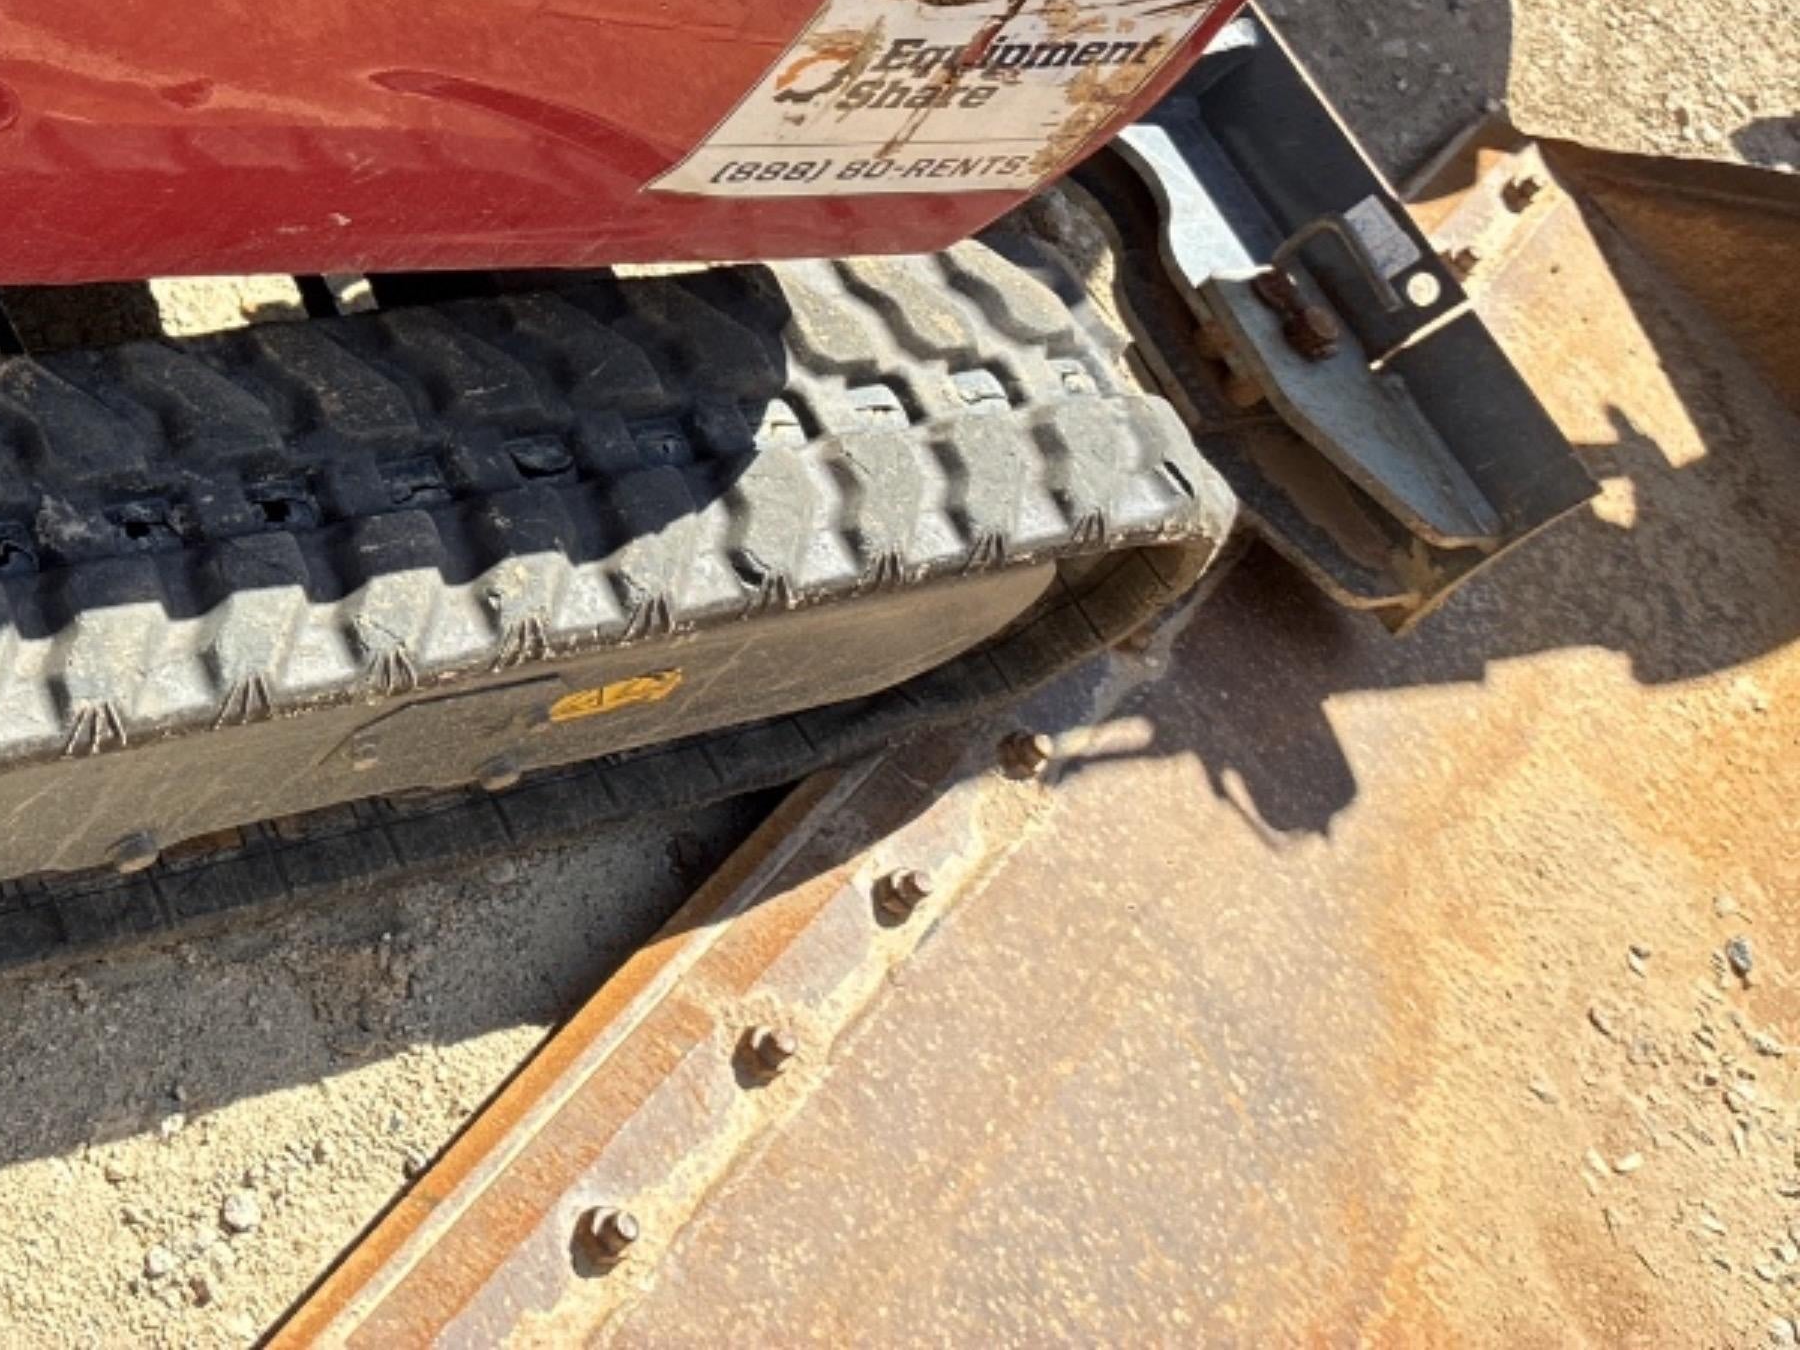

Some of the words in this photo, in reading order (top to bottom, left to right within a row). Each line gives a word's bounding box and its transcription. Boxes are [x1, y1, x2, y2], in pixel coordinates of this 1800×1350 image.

[835, 79, 999, 110] Share
[709, 159, 832, 184] (888)
[835, 154, 1030, 181] 80-RENTS
